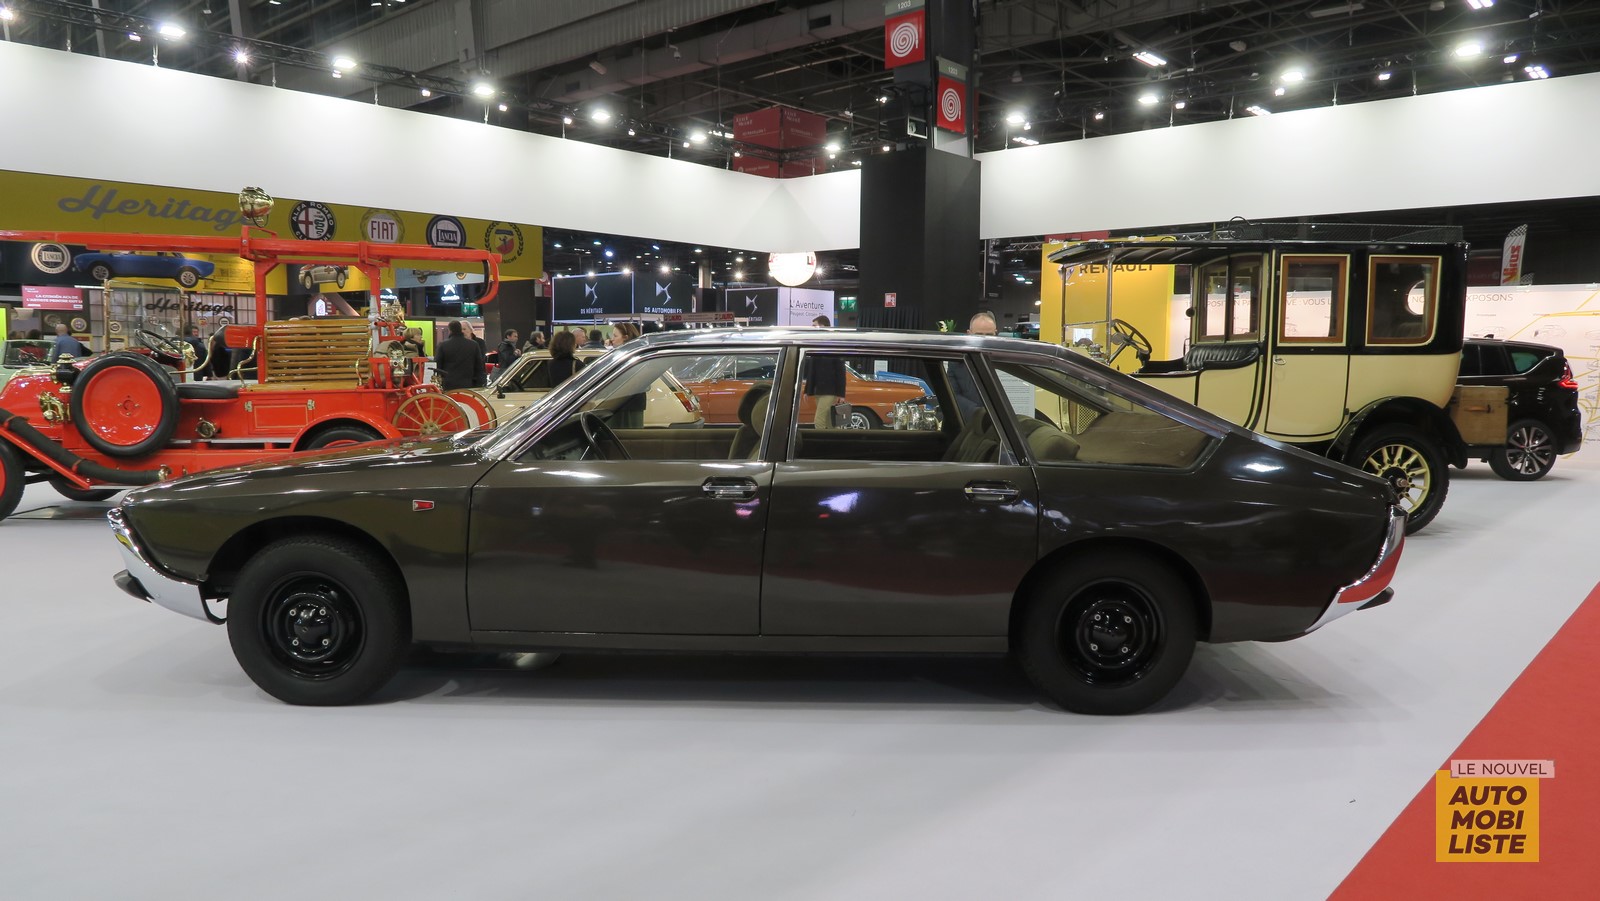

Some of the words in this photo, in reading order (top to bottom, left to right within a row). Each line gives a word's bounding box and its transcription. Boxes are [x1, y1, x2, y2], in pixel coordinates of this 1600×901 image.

[897, 0, 911, 9] 1203
[292, 203, 307, 222] ALFA
[310, 201, 334, 226] ROMEO
[371, 220, 395, 240] FIAT
[438, 229, 458, 242] LANCIA
[145, 297, 235, 315] Heitage
